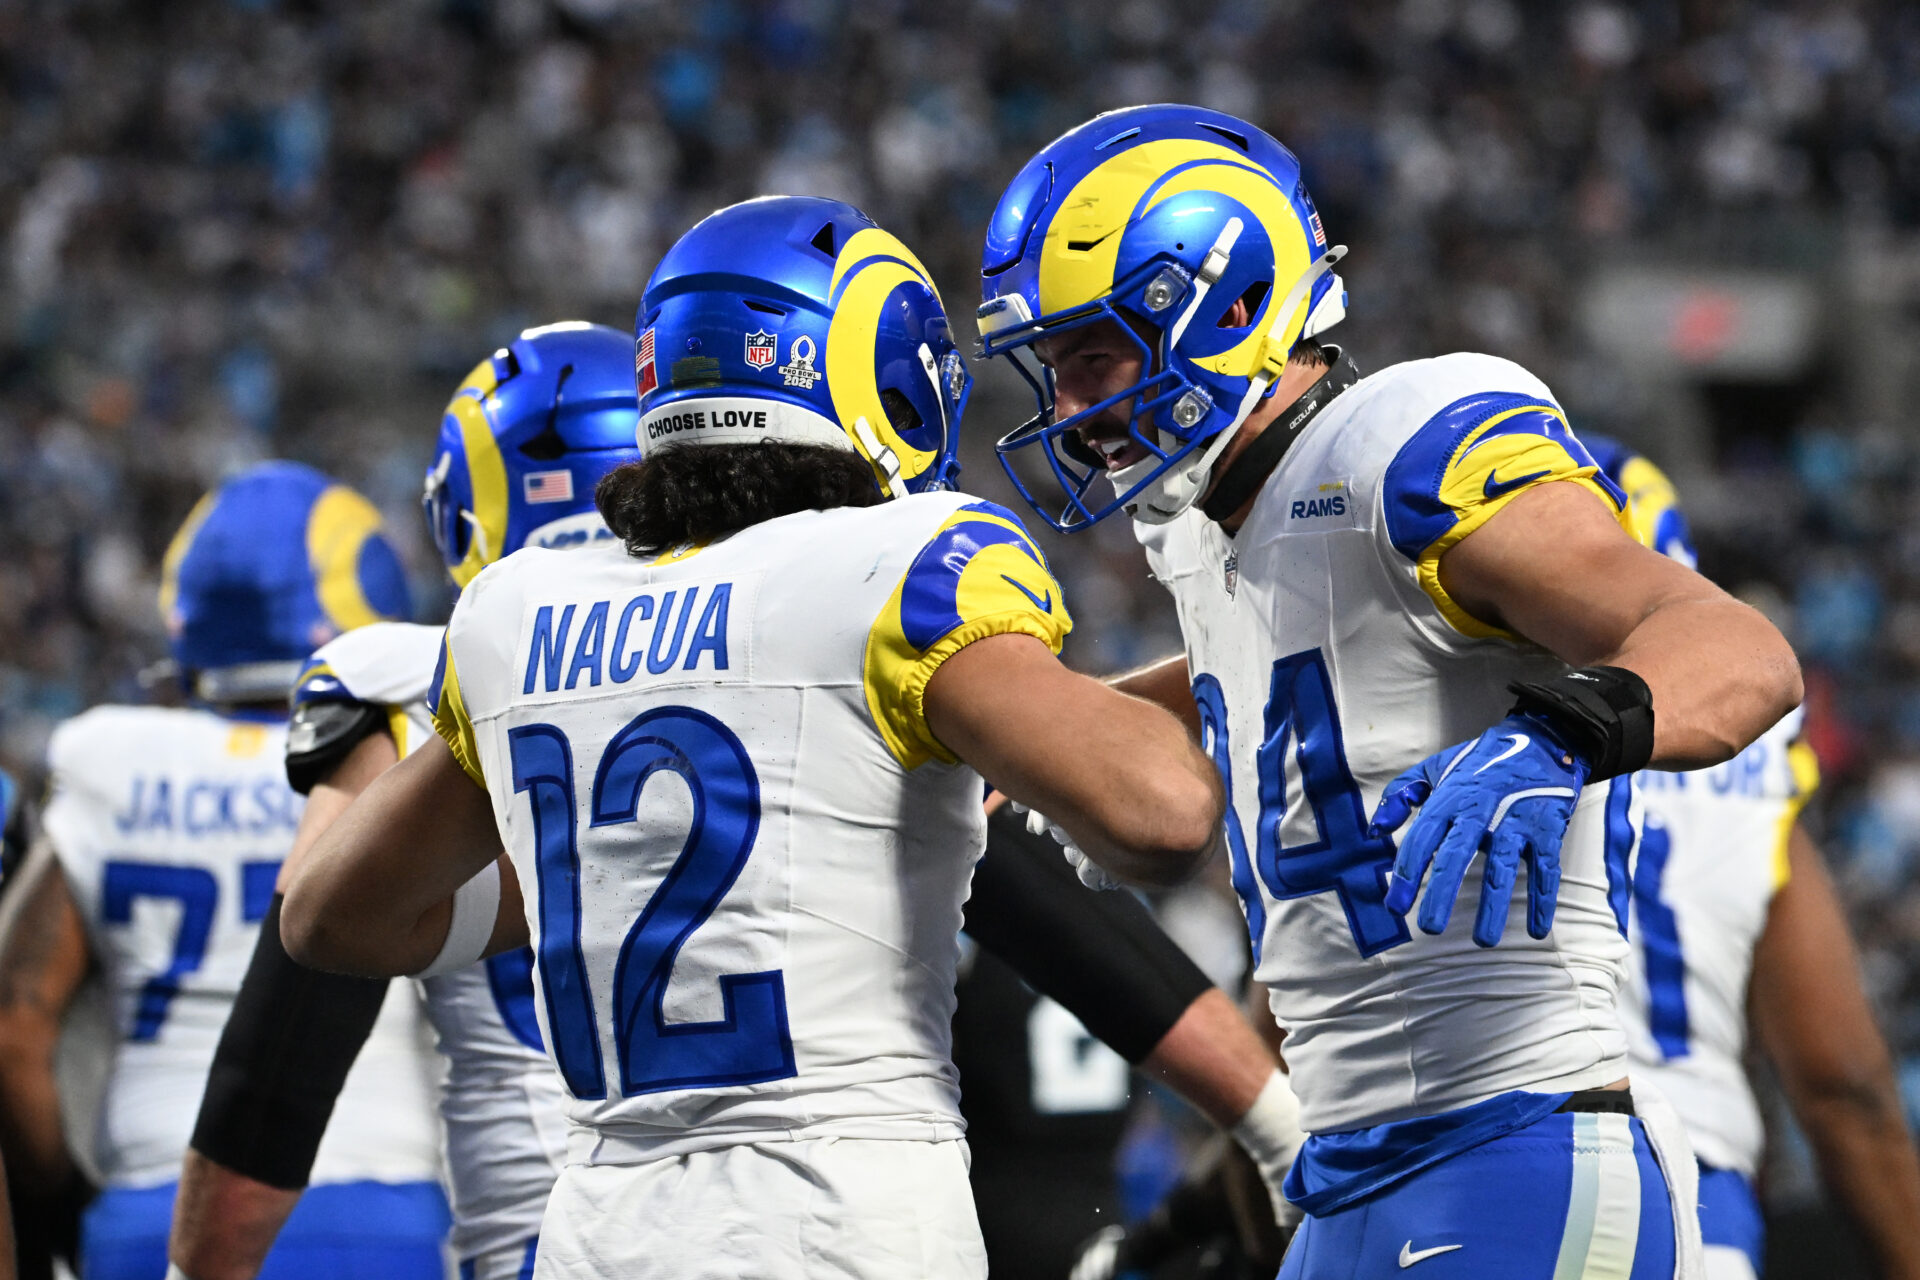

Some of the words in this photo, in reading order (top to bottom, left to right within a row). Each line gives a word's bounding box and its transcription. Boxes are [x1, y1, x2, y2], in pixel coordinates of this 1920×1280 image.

[749, 347, 772, 364] NFL
[783, 367, 797, 375] PRO
[797, 370, 817, 379] BOWL
[783, 375, 814, 390] 2026
[648, 412, 706, 439] CHOOSE
[711, 410, 767, 428] LOVE
[1291, 496, 1346, 519] RAMS
[523, 583, 733, 694] NACUA
[508, 705, 798, 1100] 12
